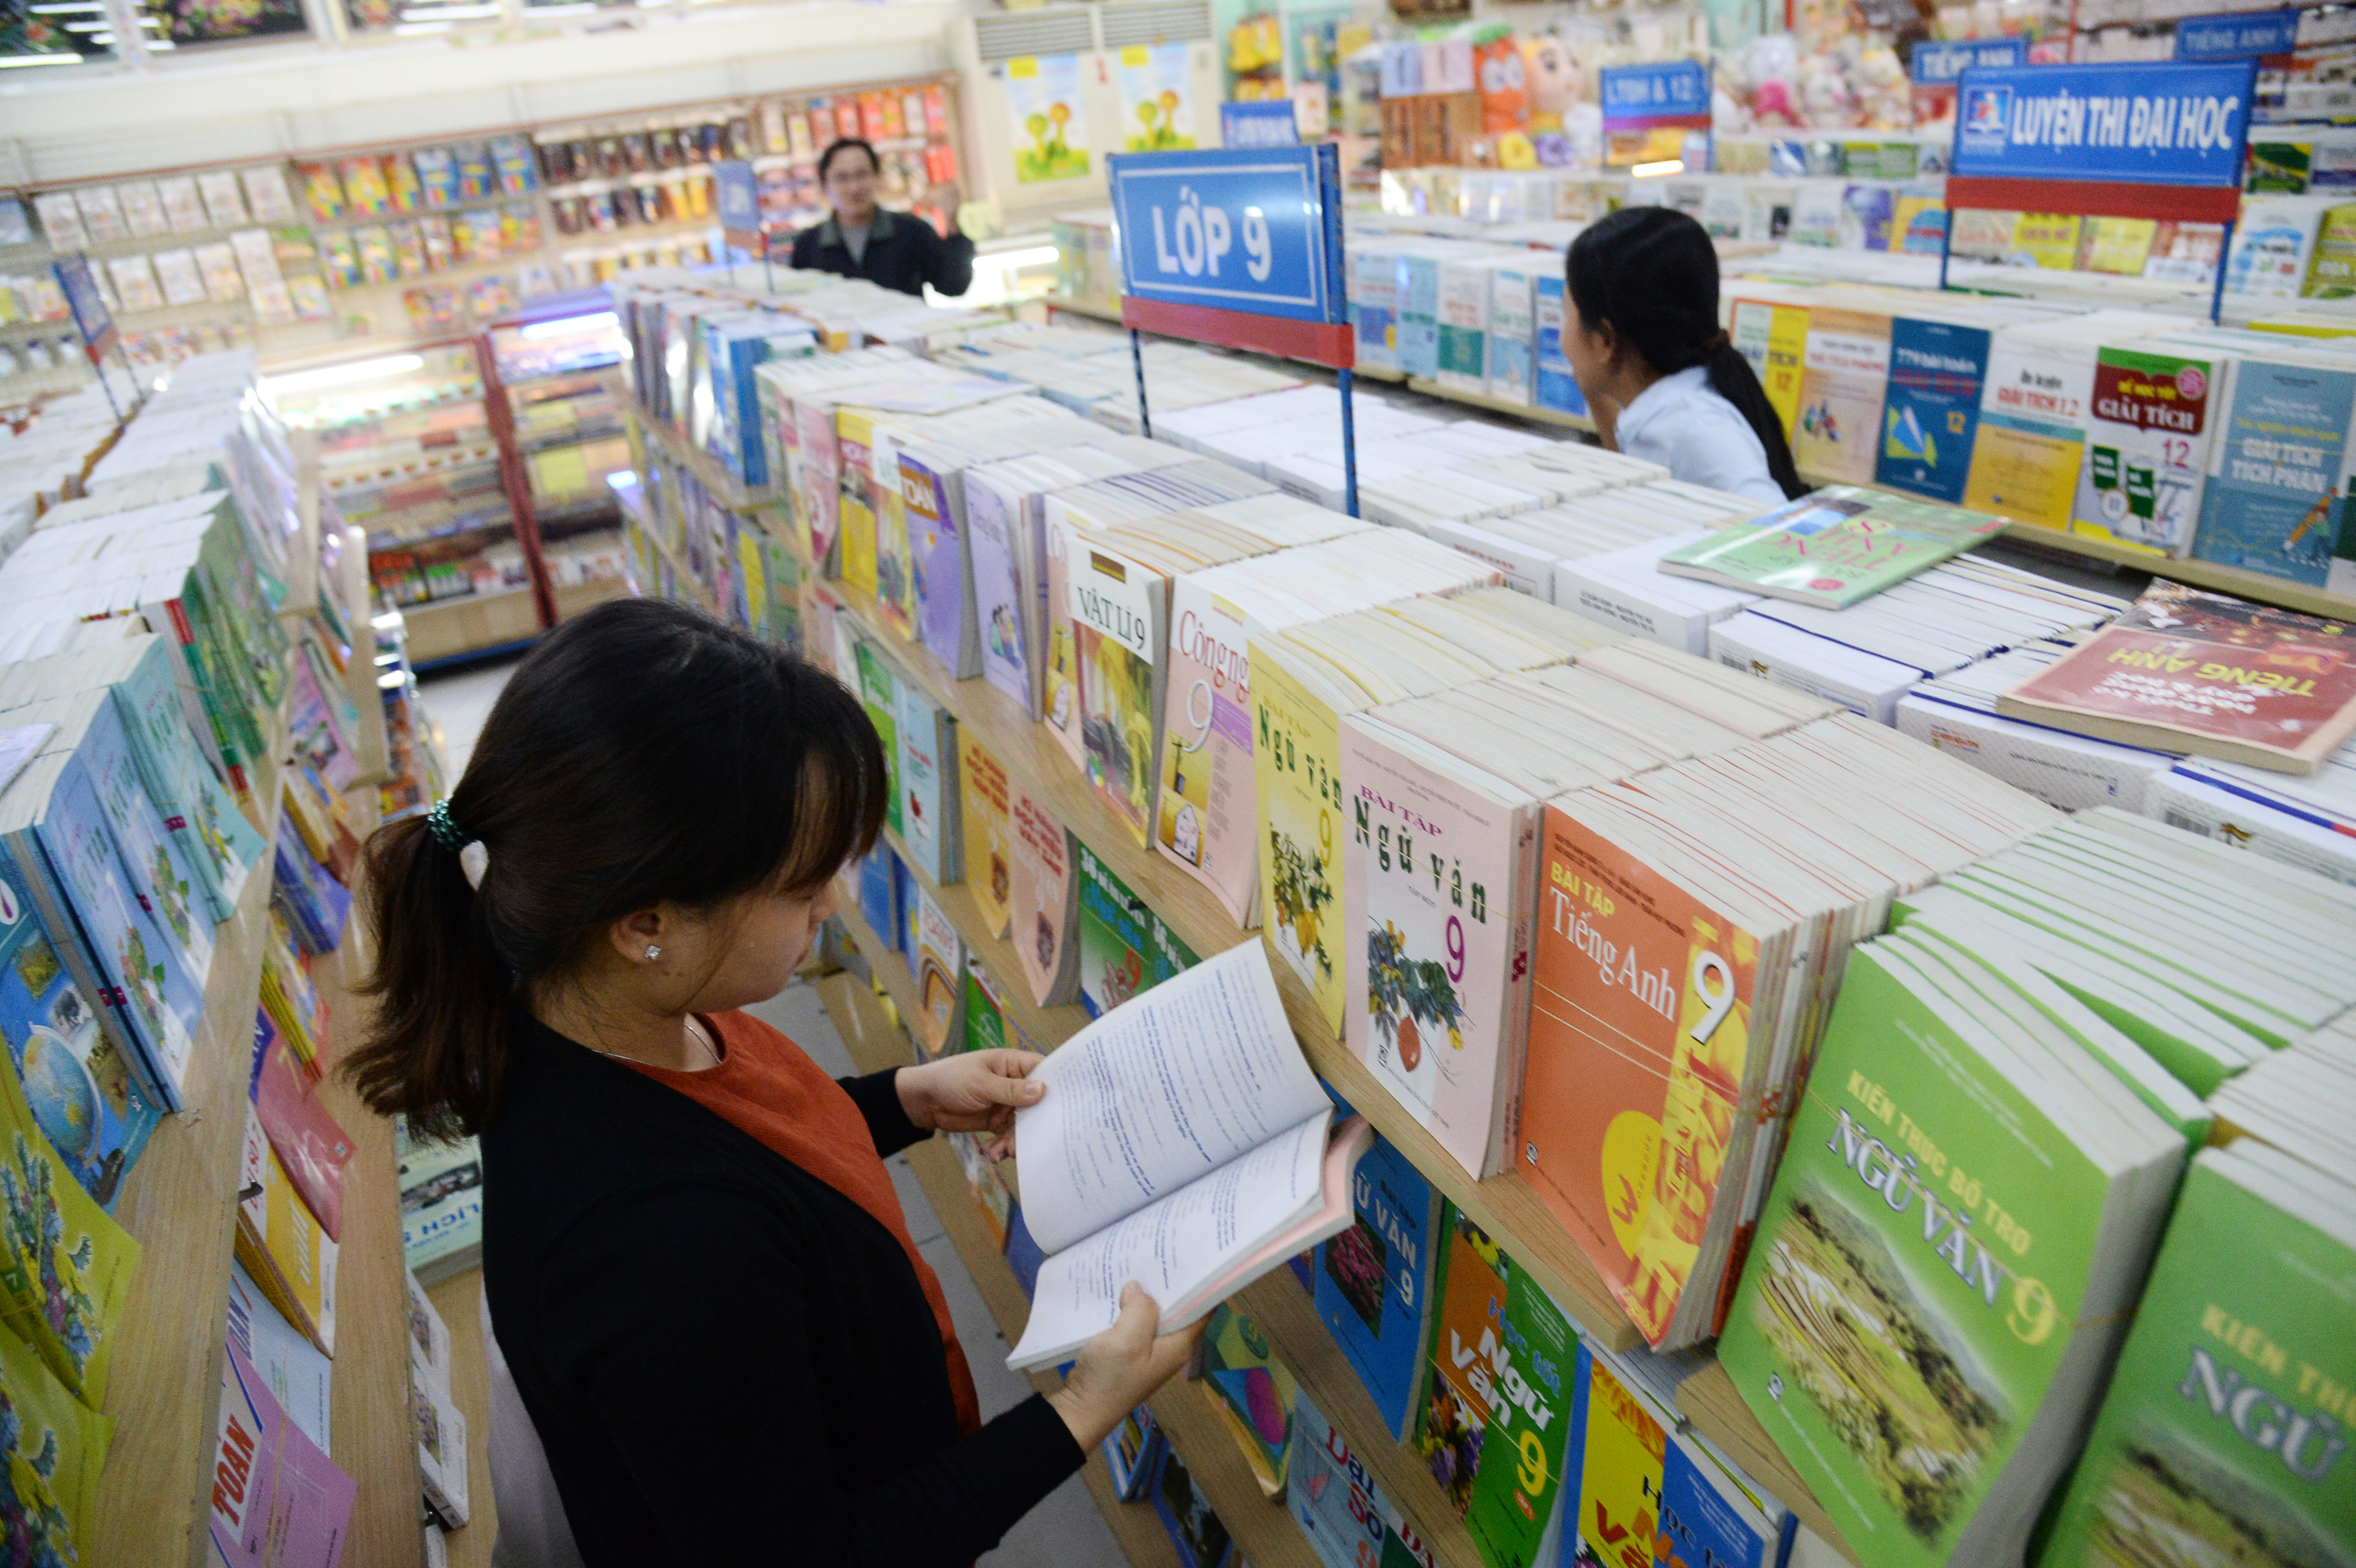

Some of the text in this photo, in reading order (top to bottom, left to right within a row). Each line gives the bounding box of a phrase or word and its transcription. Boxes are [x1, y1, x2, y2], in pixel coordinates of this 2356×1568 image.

[2011, 88, 2240, 158] LUYỆN THI ĐẠI HỌC
[1152, 185, 1272, 282] LỚP 9
[2097, 395, 2195, 430] GIẢI TÍCH
[2162, 438, 2192, 469] 12
[1134, 617, 1145, 650] 9
[2106, 647, 2197, 674] ANH
[1187, 679, 1215, 753] 9
[1318, 808, 1332, 869] 9
[1361, 784, 1443, 837] BÀI TẬP
[1353, 794, 1414, 874] Ngữ
[1430, 852, 1486, 924] văn
[1550, 860, 1615, 918] BÀI TẬP
[1446, 914, 1466, 984] 9
[1549, 885, 1618, 987] Tiếng
[1616, 945, 1677, 1023] Anh
[1688, 949, 1737, 1047] 9
[1374, 1198, 1417, 1271] VĂN
[1826, 1106, 2004, 1308] NGỮ VĂN
[1400, 1268, 1414, 1307] 9
[2007, 1275, 2054, 1346] 9
[1450, 1327, 1512, 1429] Văn
[1478, 1326, 1555, 1433] Ngữ
[1488, 1294, 1529, 1357] Học
[1532, 1349, 1560, 1400] tốt
[210, 1413, 257, 1528] TOÁN
[1516, 1429, 1548, 1497] 9
[1642, 1473, 1698, 1550] Học
